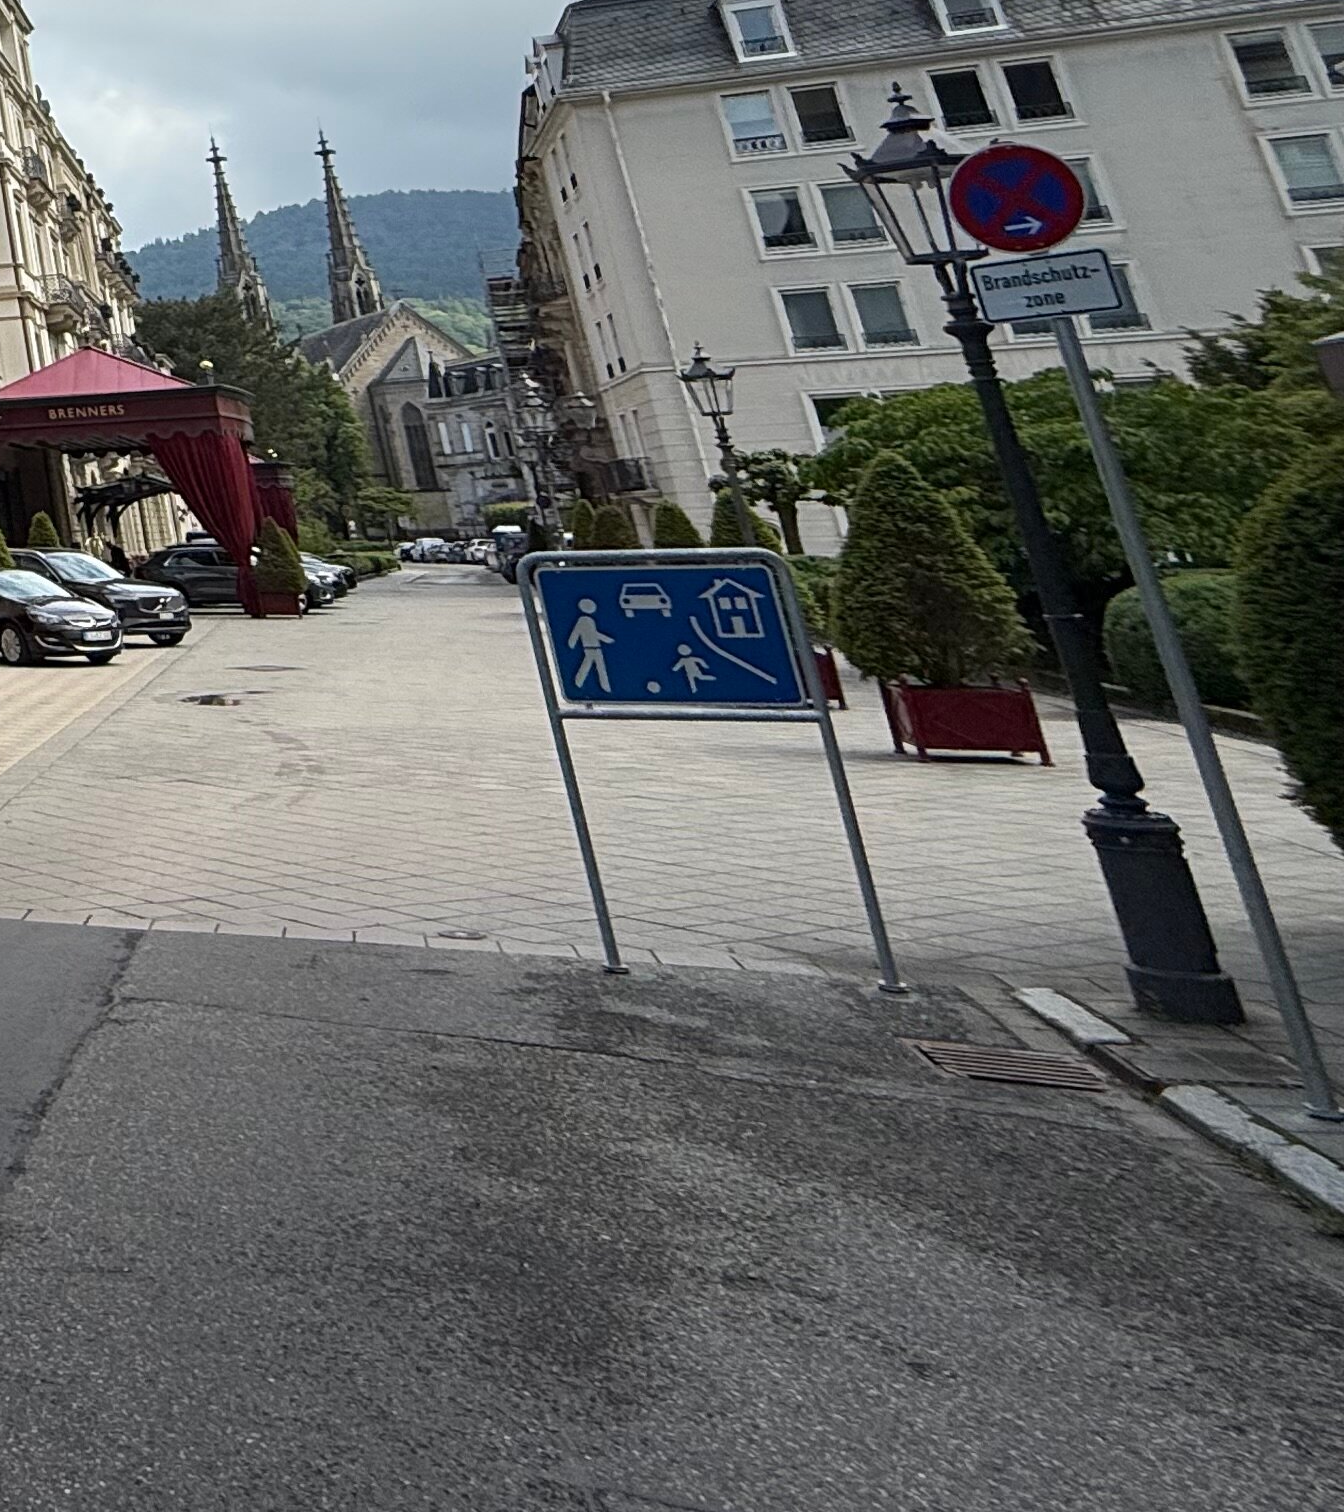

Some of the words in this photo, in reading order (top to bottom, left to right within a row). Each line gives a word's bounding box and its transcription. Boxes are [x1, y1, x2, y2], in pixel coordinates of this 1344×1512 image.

[981, 264, 1100, 291] Brandschutz-
[1023, 292, 1066, 308] zone
[48, 404, 125, 420] BRENNERS
